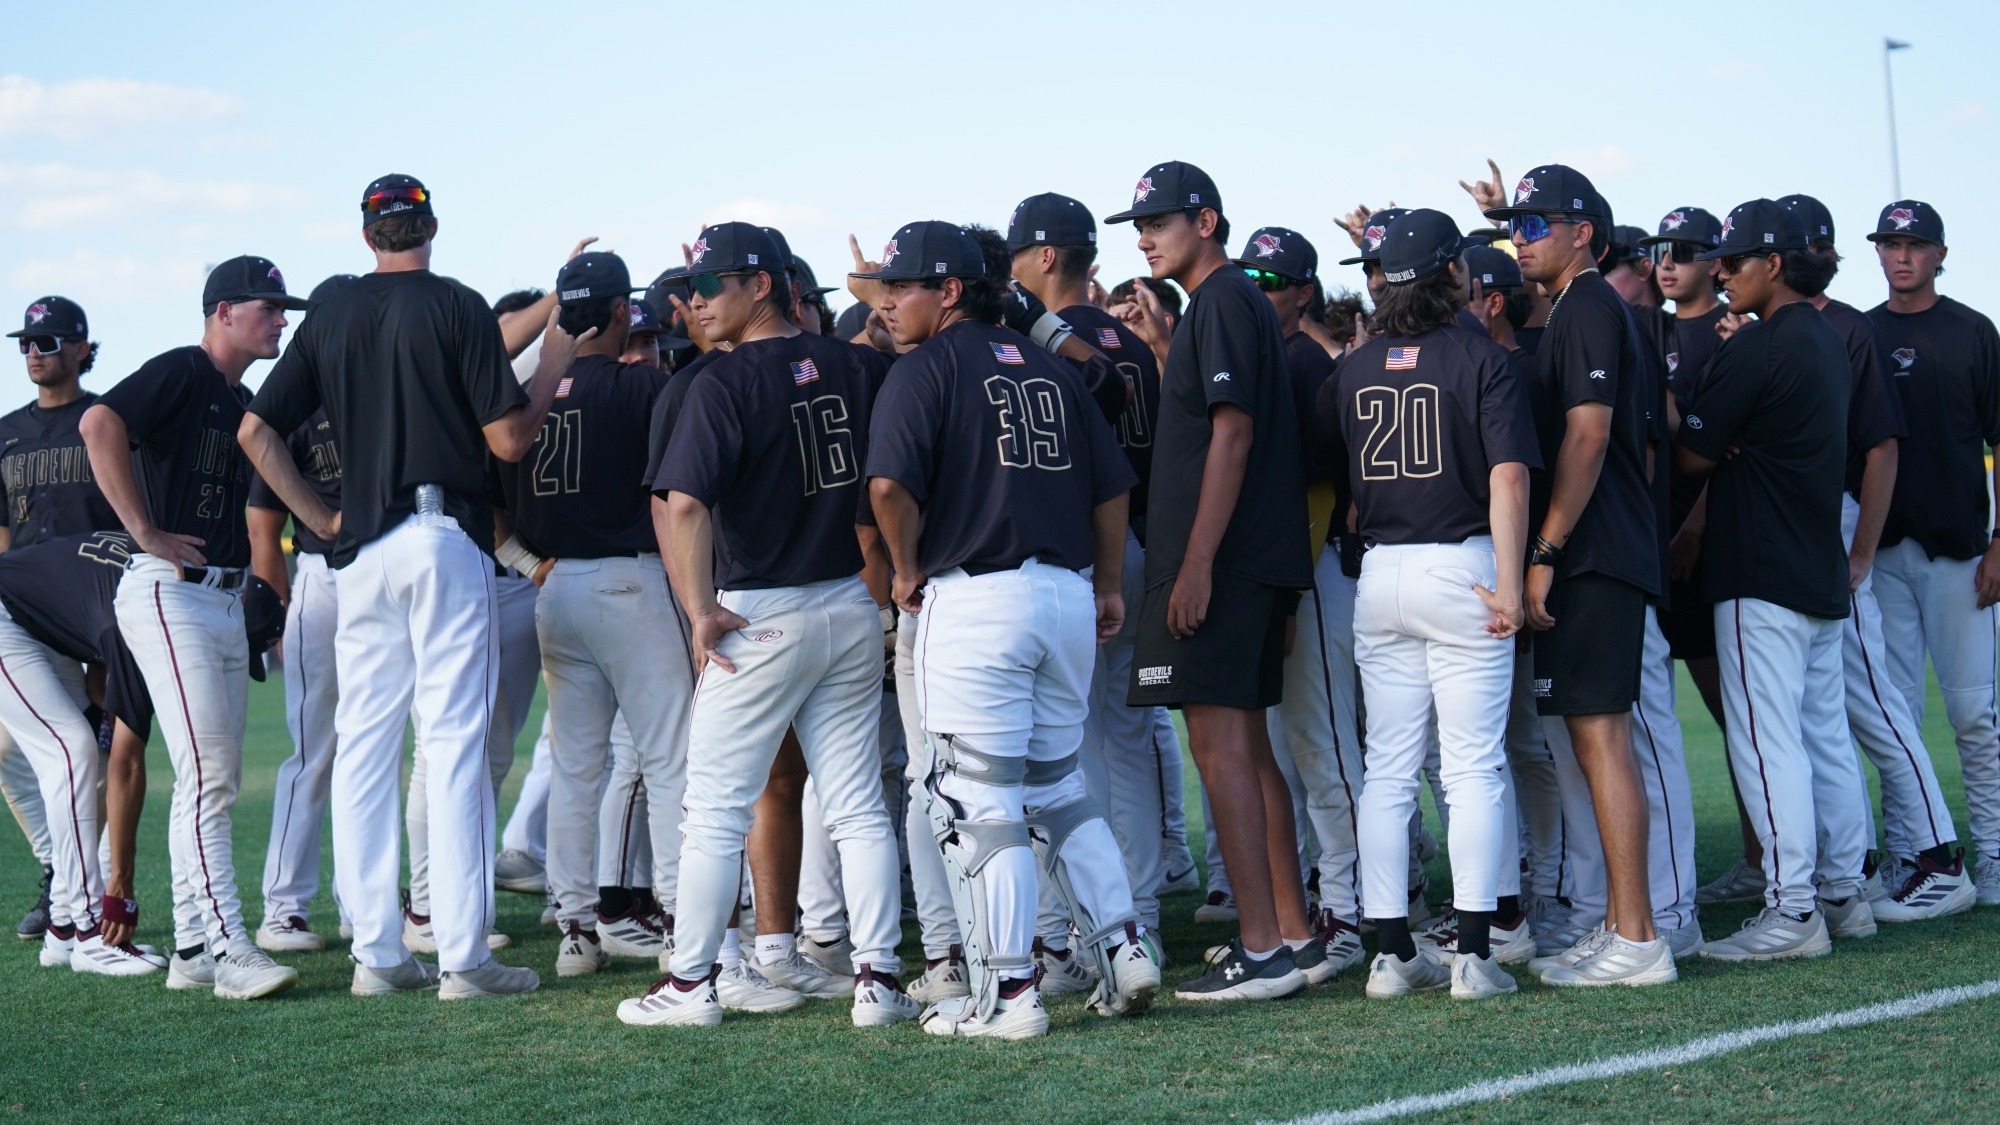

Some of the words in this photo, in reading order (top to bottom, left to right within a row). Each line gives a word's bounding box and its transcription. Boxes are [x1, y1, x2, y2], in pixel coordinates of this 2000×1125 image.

[562, 287, 590, 300] DUSTDEVILS
[532, 409, 582, 496] 21
[790, 394, 859, 496] 16
[983, 375, 1072, 471] 39
[1356, 383, 1443, 480] 20
[197, 483, 225, 518] 27
[1138, 665, 1172, 678] DUSTDEVILS
